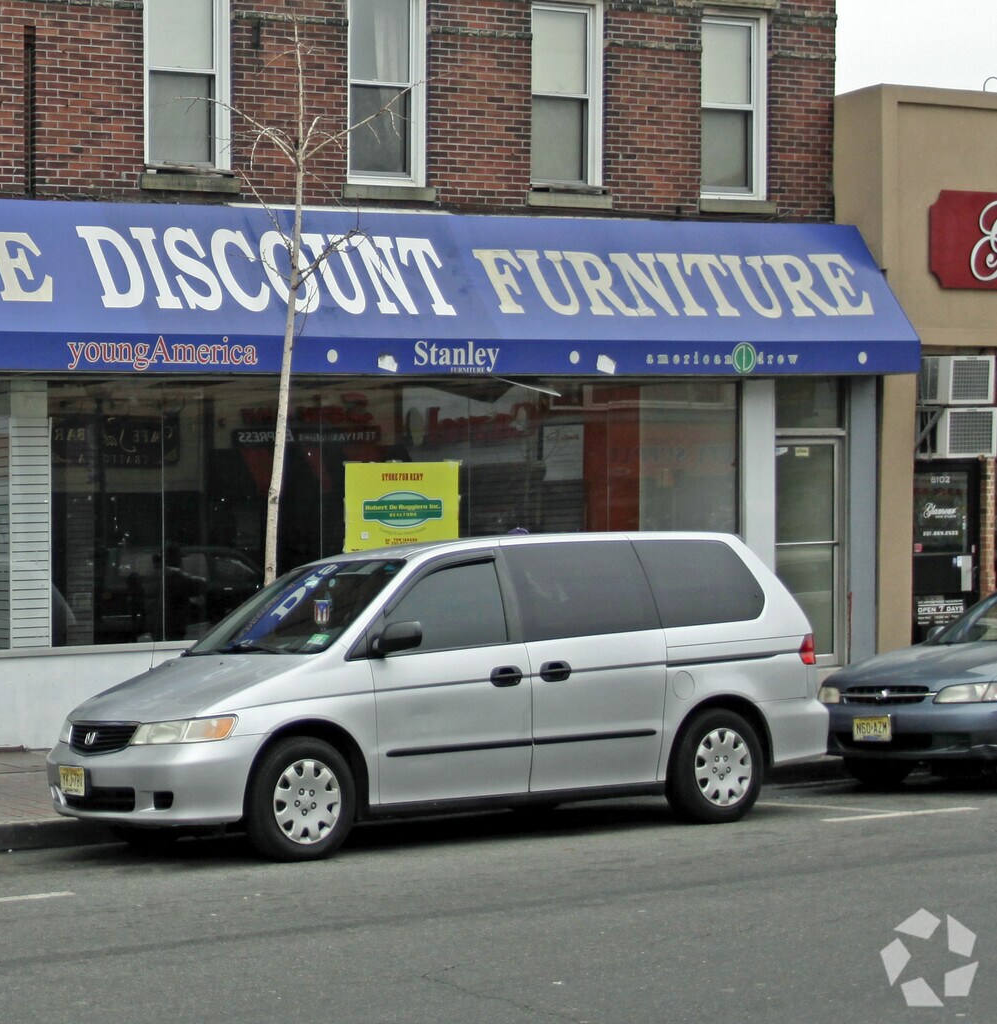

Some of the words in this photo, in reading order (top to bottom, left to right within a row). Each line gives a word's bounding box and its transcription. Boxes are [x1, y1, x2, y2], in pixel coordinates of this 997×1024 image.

[75, 225, 457, 317] DISCOUNT
[471, 249, 875, 319] FURNITURE
[413, 340, 500, 373] Stanley
[450, 366, 486, 374] FURNITURE
[381, 472, 398, 482] STORE
[410, 472, 424, 481] RENT
